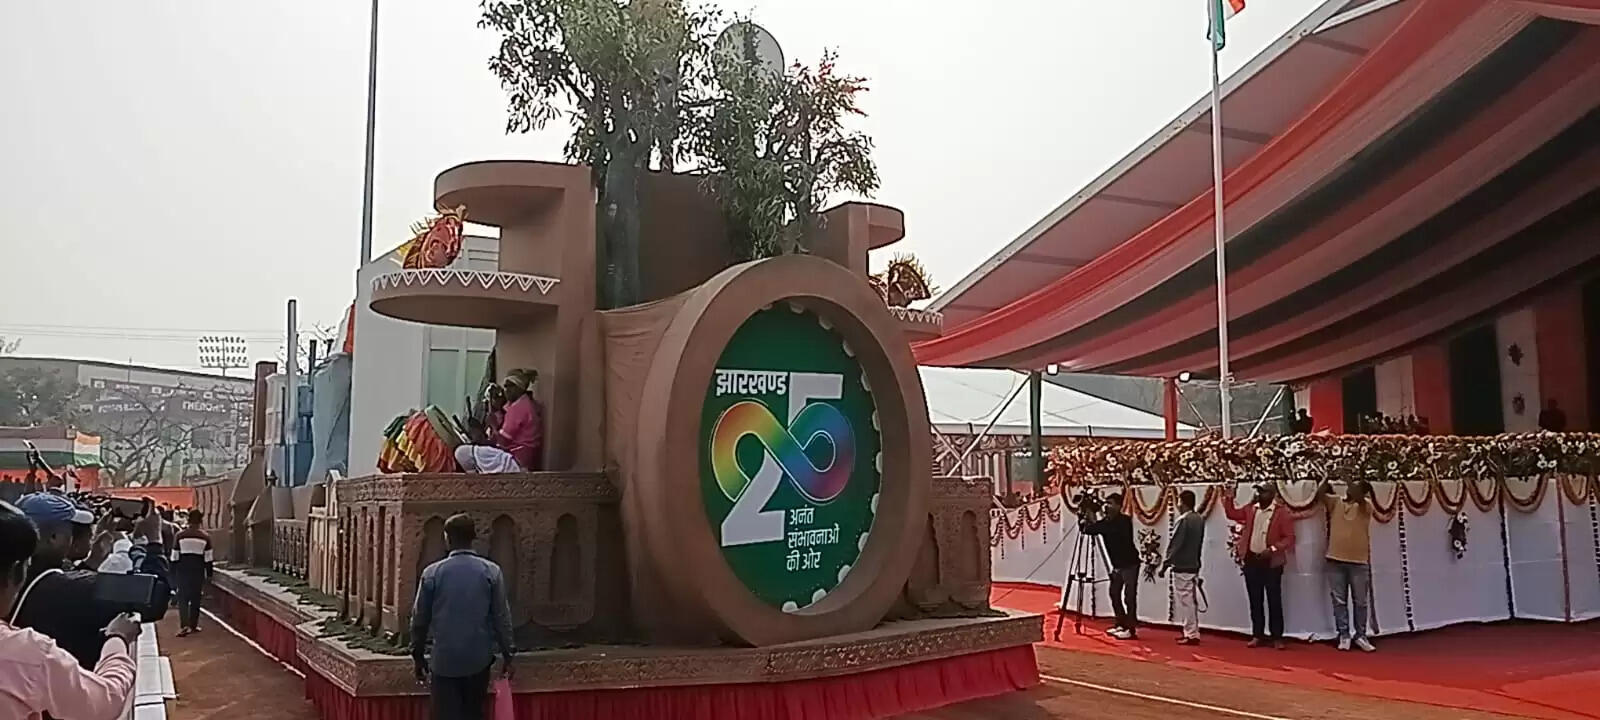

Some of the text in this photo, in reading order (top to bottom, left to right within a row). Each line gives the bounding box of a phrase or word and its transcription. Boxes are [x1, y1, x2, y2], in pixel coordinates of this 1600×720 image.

[715, 368, 789, 396] झारखण्ड
[789, 504, 815, 525] अनंत
[786, 547, 822, 571] की ओर
